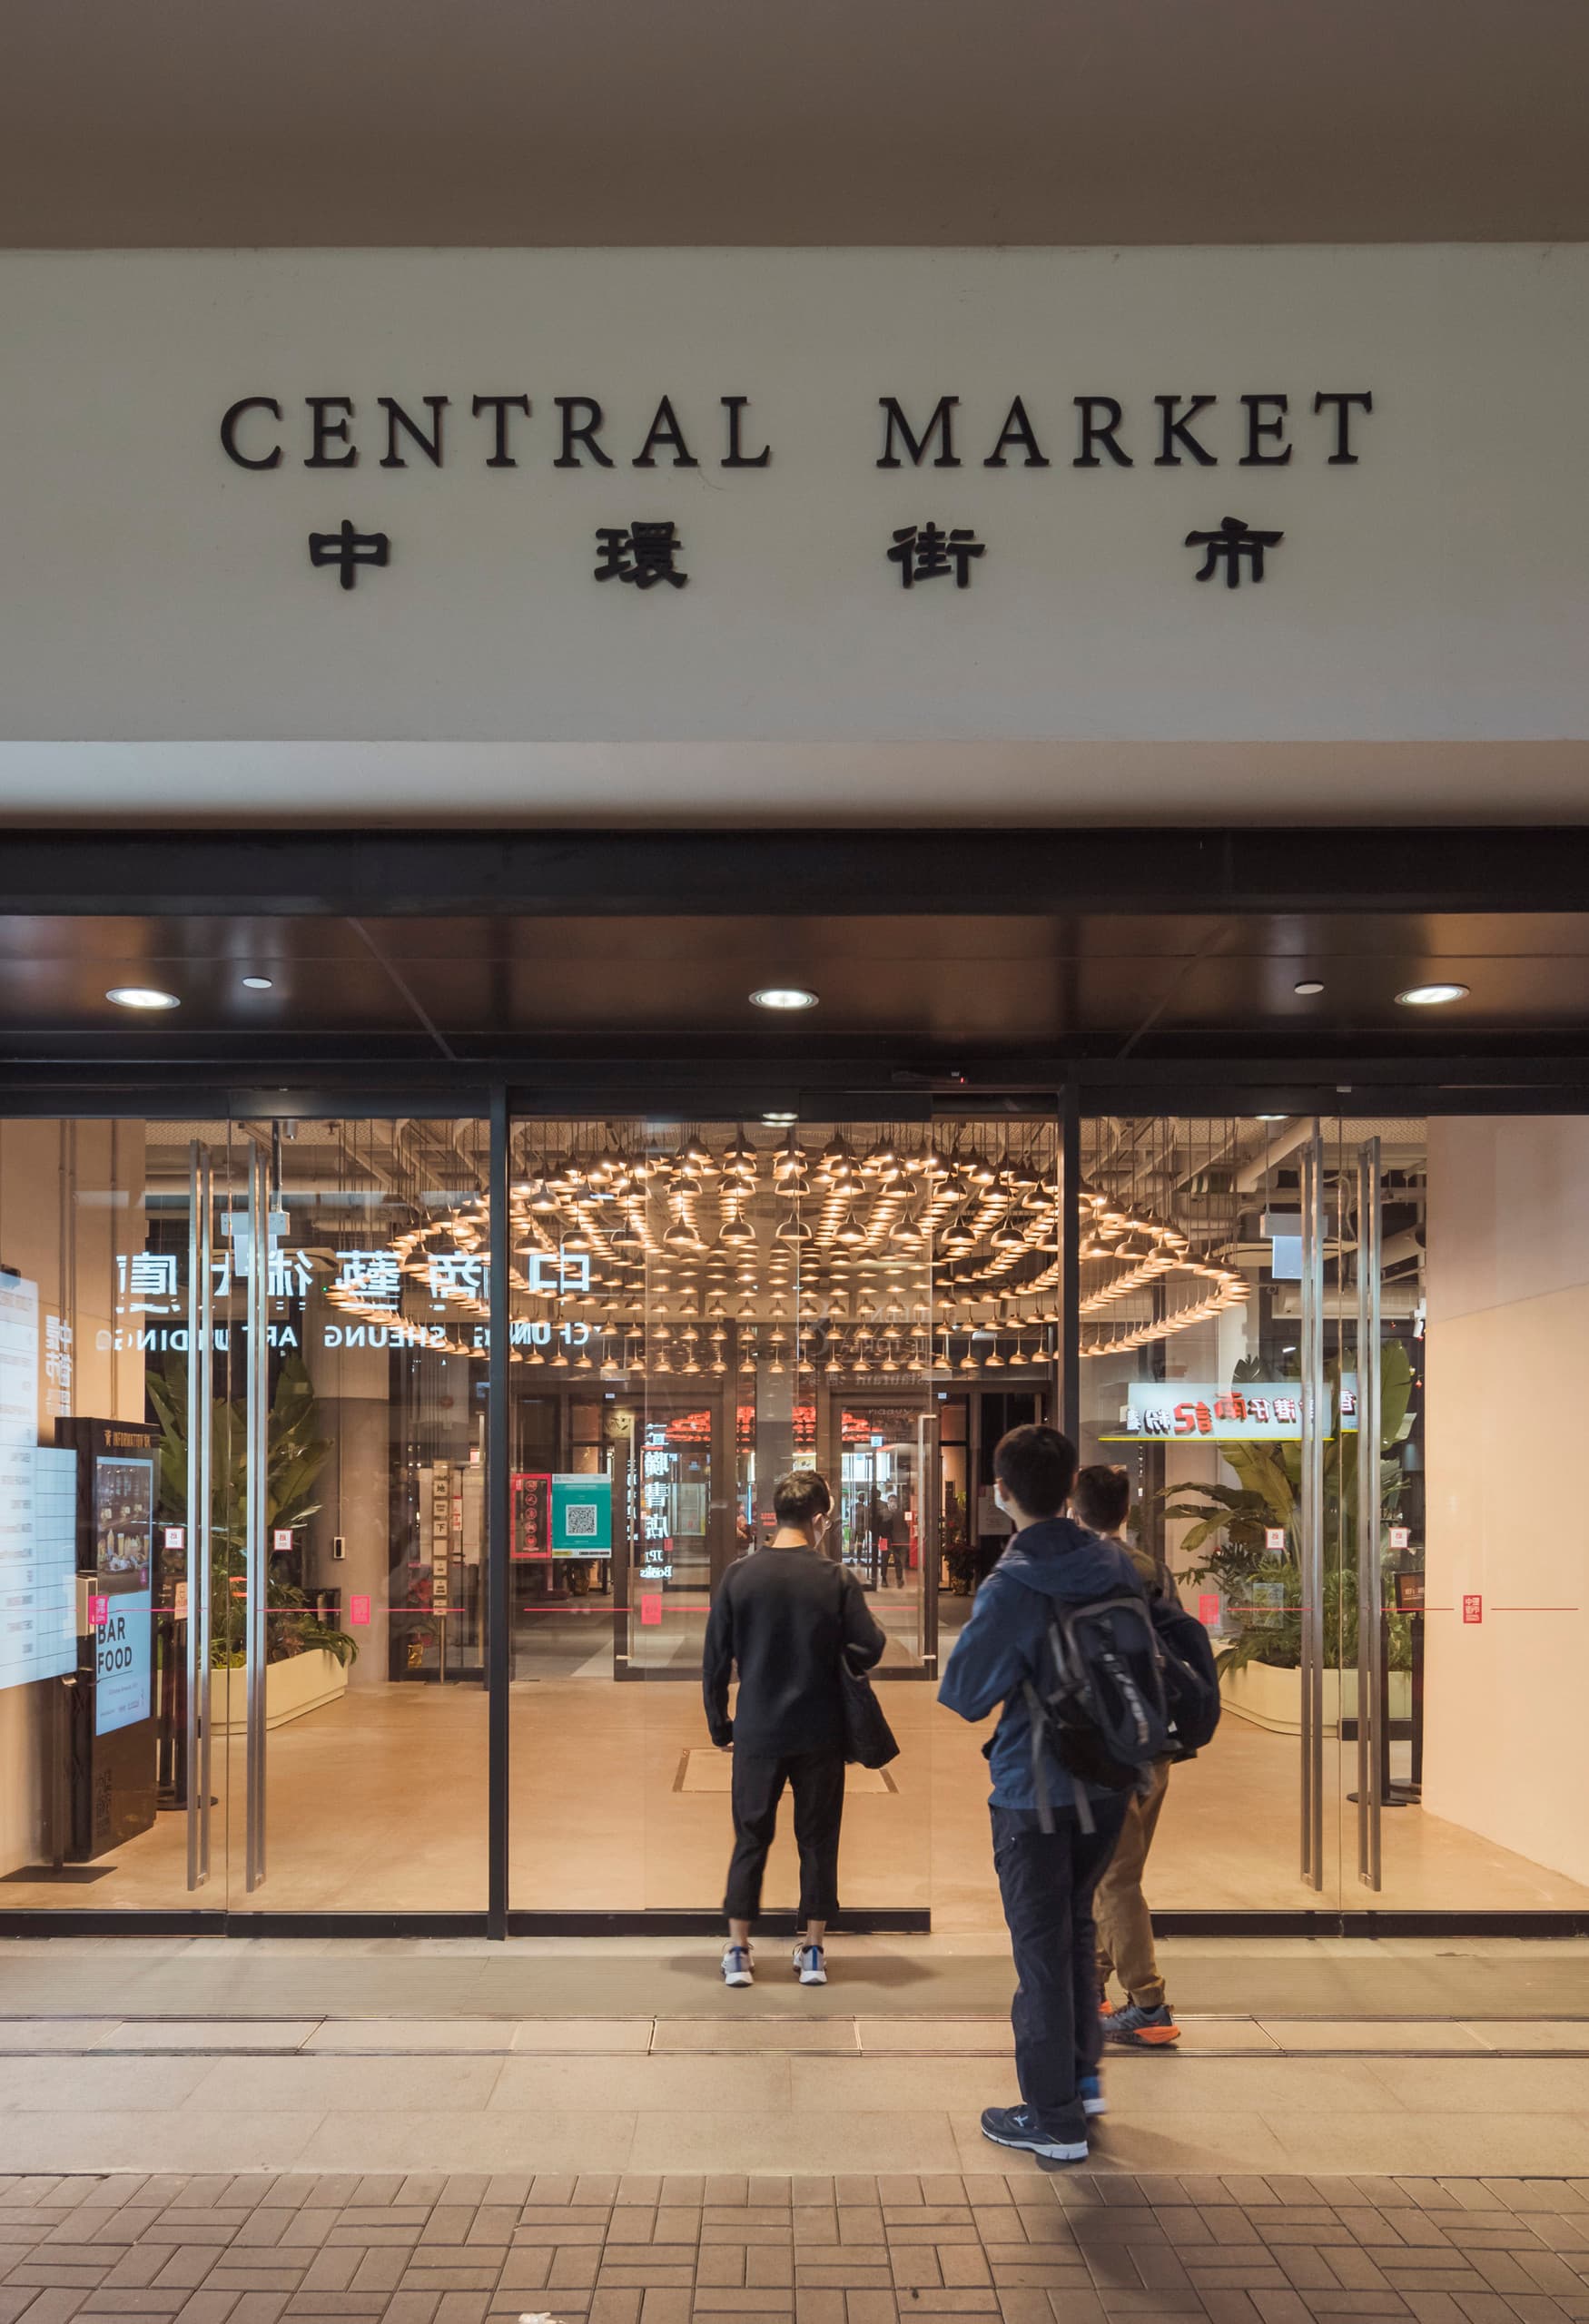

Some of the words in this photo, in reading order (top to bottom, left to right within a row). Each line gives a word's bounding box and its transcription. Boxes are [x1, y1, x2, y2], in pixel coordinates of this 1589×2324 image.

[220, 394, 771, 470] CENTRAL
[875, 390, 1373, 468] MARKET
[308, 516, 1285, 590] 中環街市
[97, 1616, 126, 1645] BAR
[97, 1646, 133, 1675] FOOD
